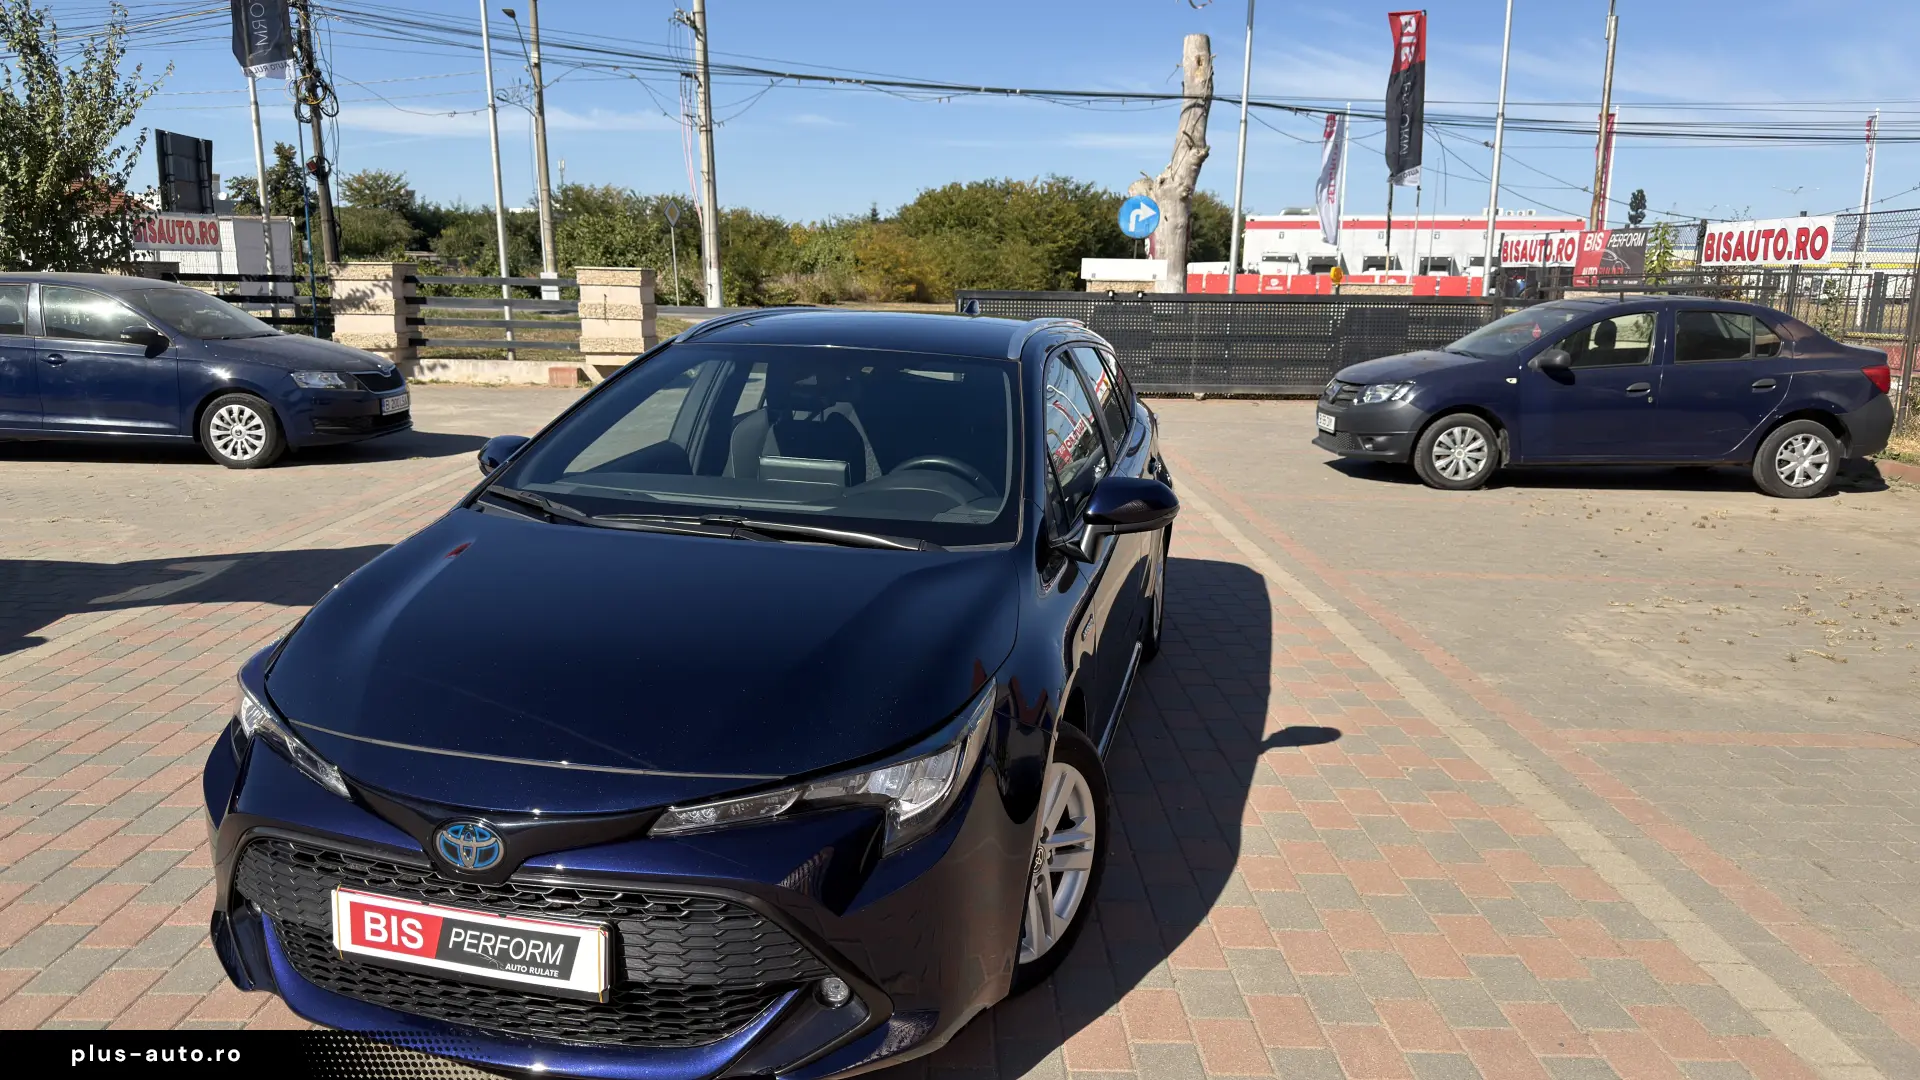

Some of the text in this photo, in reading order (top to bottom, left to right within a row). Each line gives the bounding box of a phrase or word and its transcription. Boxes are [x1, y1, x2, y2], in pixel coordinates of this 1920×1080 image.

[1502, 237, 1576, 263] BISAUTO.RO
[1583, 231, 1646, 252] BIS PERFORM
[1704, 226, 1829, 262] BISAUTO.RO
[363, 910, 565, 966] BIS PERFORM
[505, 962, 559, 978] AUTO RULATE
